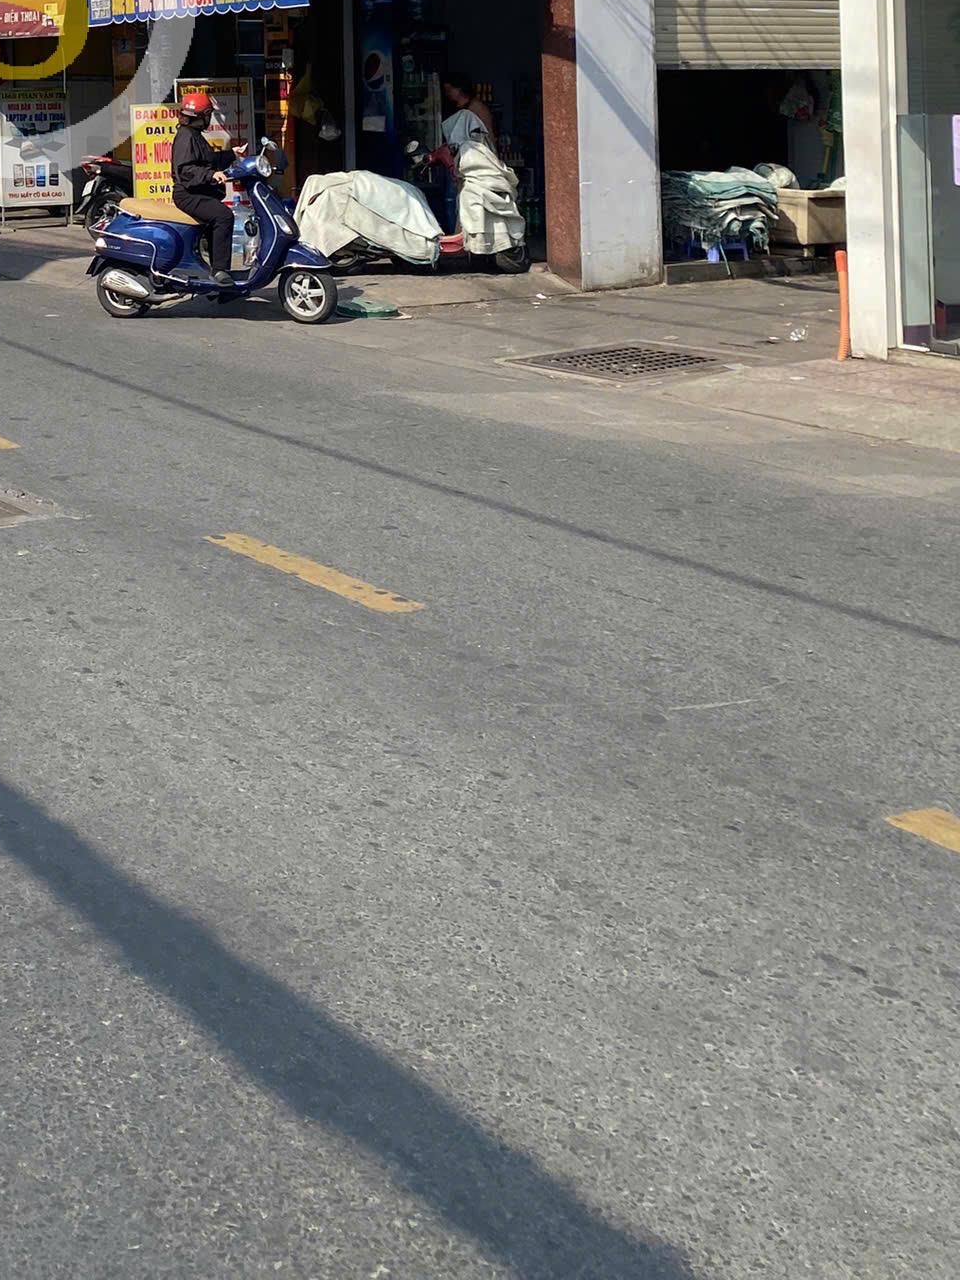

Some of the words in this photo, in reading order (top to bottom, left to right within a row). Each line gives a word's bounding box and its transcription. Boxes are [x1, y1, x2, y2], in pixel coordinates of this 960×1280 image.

[4, 9, 18, 25] ĐIỆN
[21, 10, 40, 24] THOẠI
[146, 127, 165, 136] ĐẠI
[135, 143, 148, 164] BIA
[154, 138, 172, 164] NƯỚ
